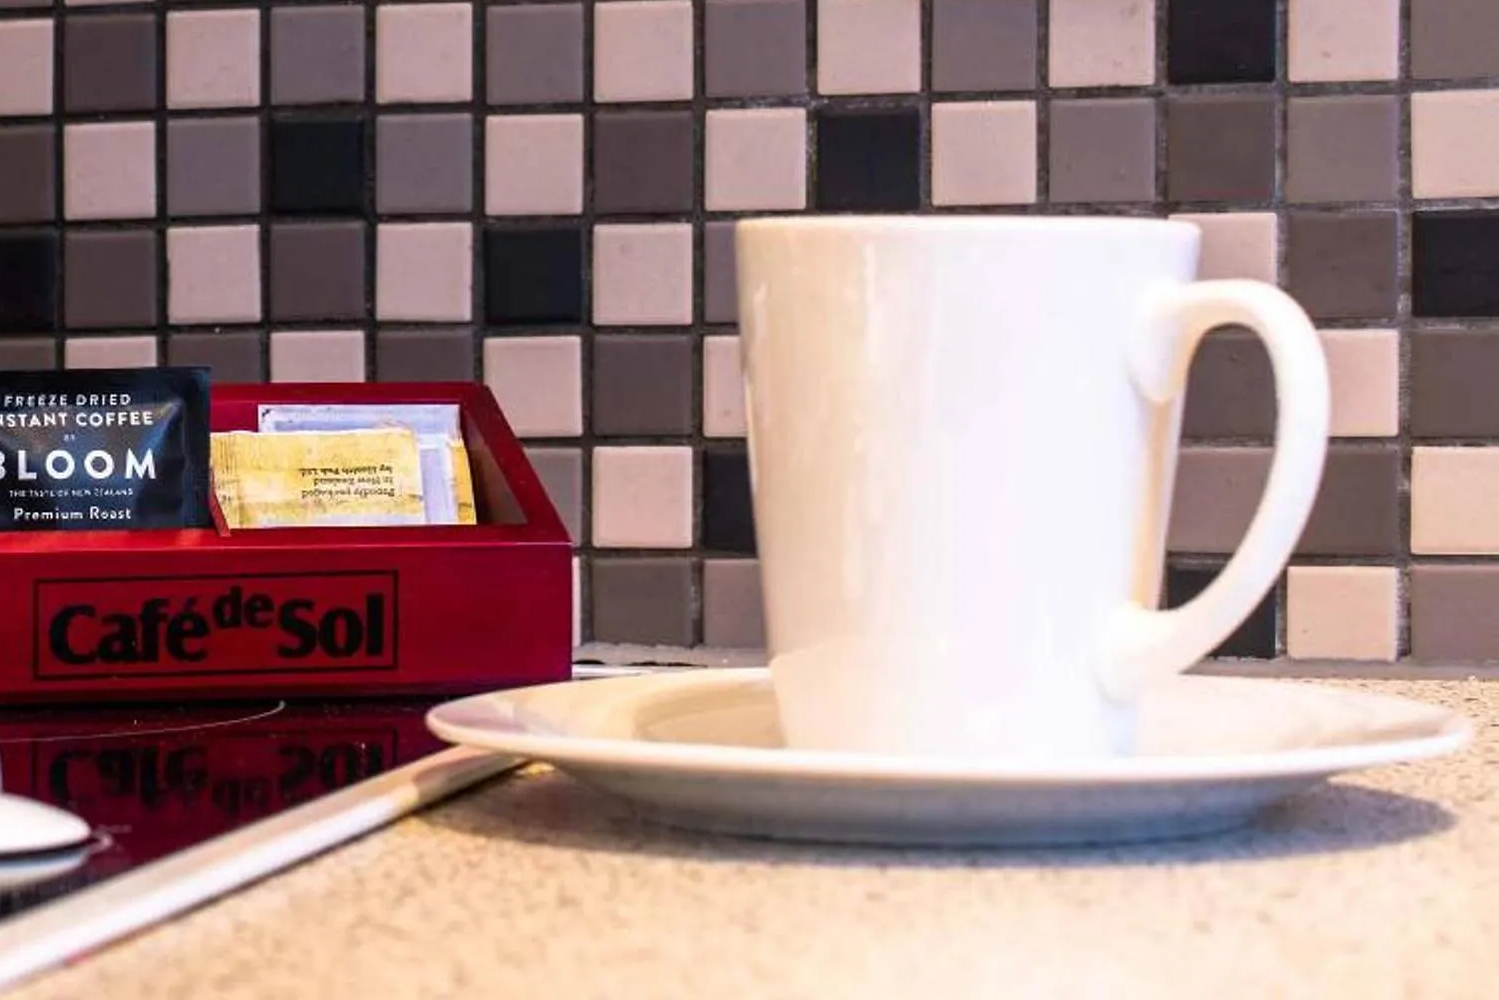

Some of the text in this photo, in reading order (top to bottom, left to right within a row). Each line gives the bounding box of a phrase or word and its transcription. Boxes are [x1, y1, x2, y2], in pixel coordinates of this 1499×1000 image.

[3, 394, 132, 408] FREEZE DRIED
[75, 411, 154, 427] COFFEE
[13, 505, 132, 520] Premium Roast
[48, 586, 384, 665] Café de Sol
